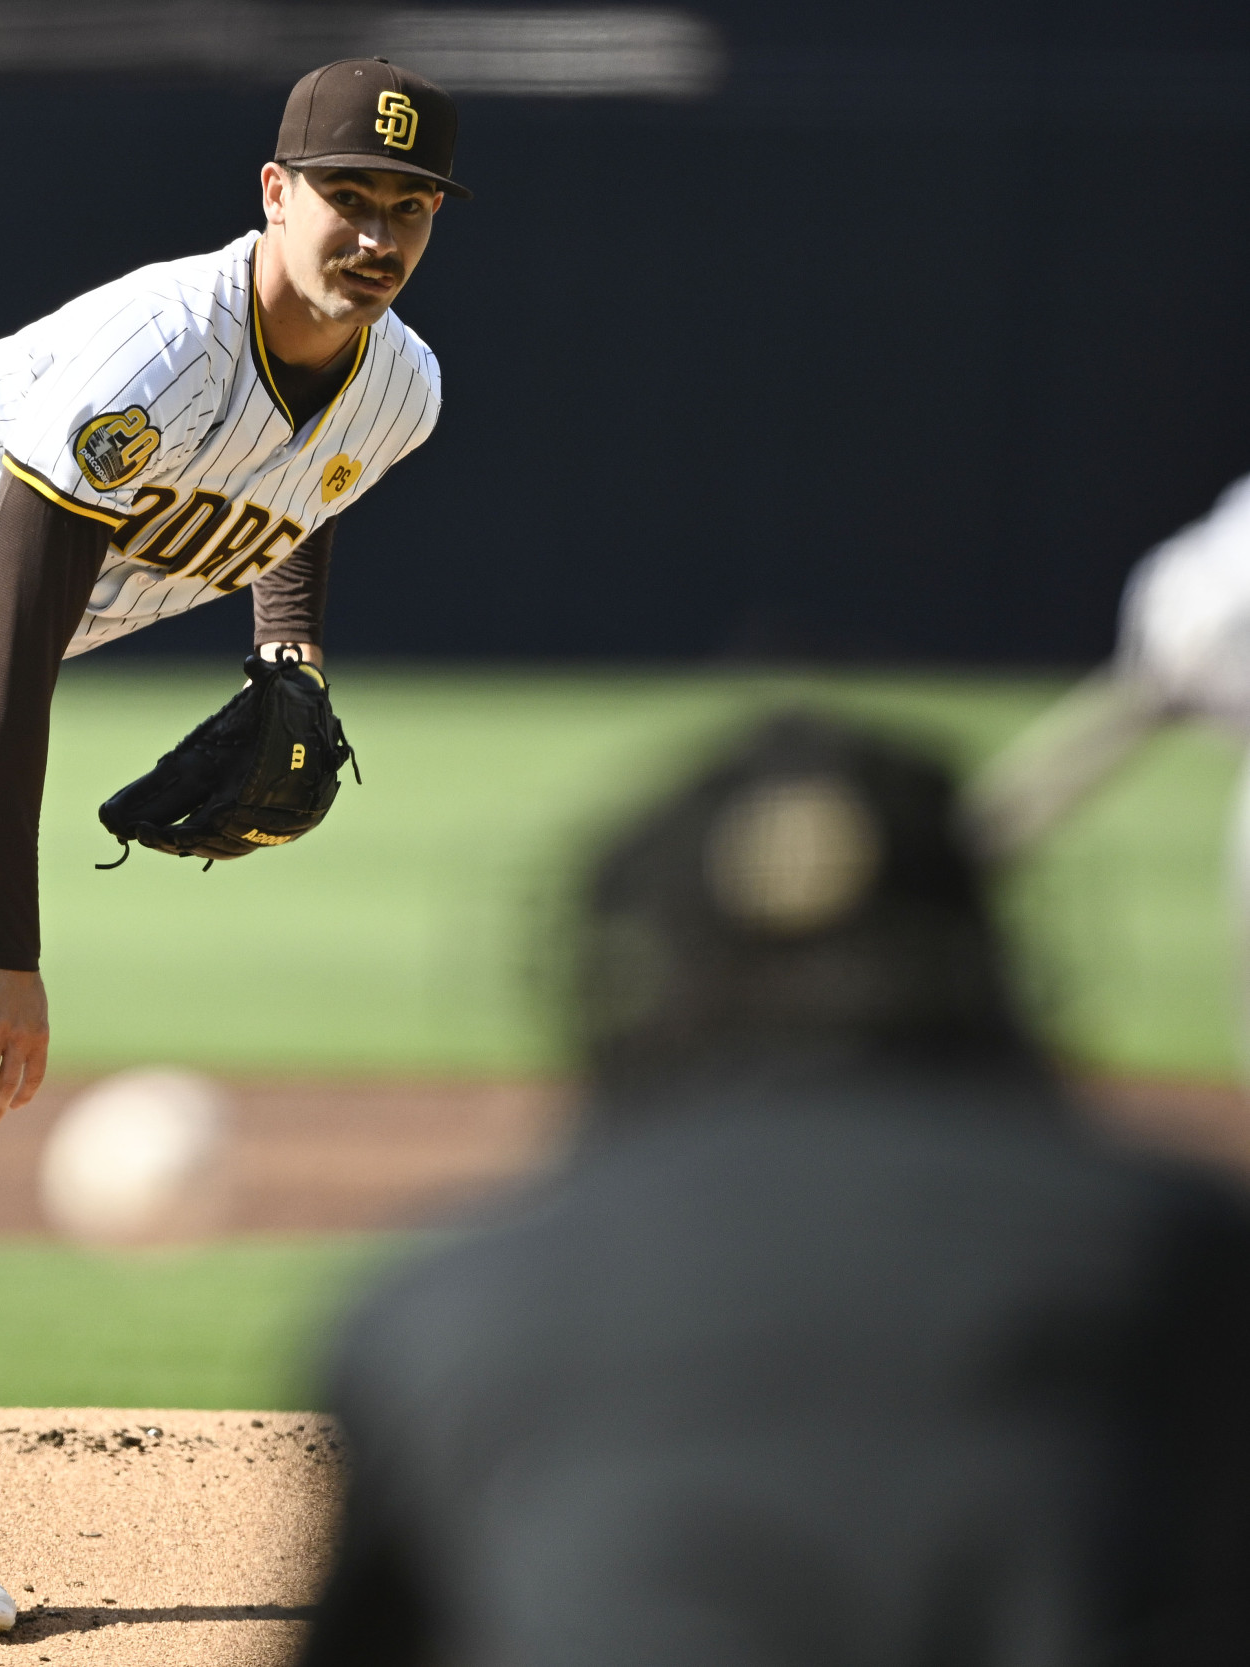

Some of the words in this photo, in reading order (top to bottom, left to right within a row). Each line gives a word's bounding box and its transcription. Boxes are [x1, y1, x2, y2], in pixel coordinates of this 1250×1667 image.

[375, 90, 419, 151] SD
[106, 408, 161, 467] 20
[326, 465, 352, 492] PS
